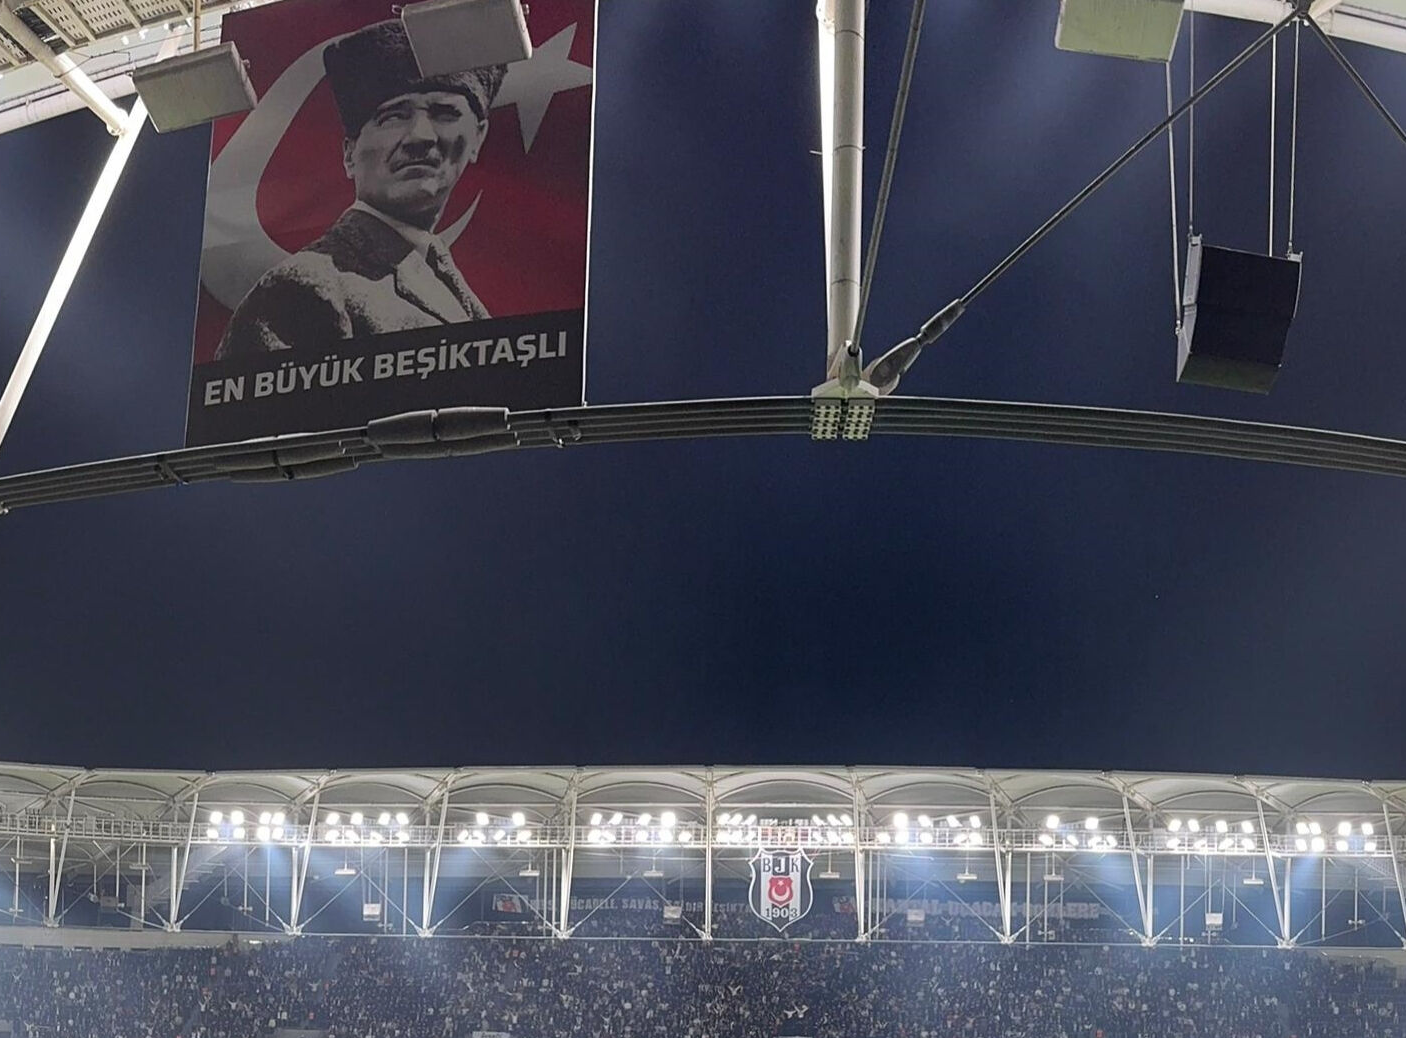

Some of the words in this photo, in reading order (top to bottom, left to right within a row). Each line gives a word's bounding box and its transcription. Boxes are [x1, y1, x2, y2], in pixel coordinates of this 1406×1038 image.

[204, 375, 246, 406] EN
[254, 355, 365, 399] BÜYÜK
[373, 331, 567, 381] BEŞİKTAŞLI
[762, 857, 800, 873] BJK
[765, 907, 798, 918] 1903
